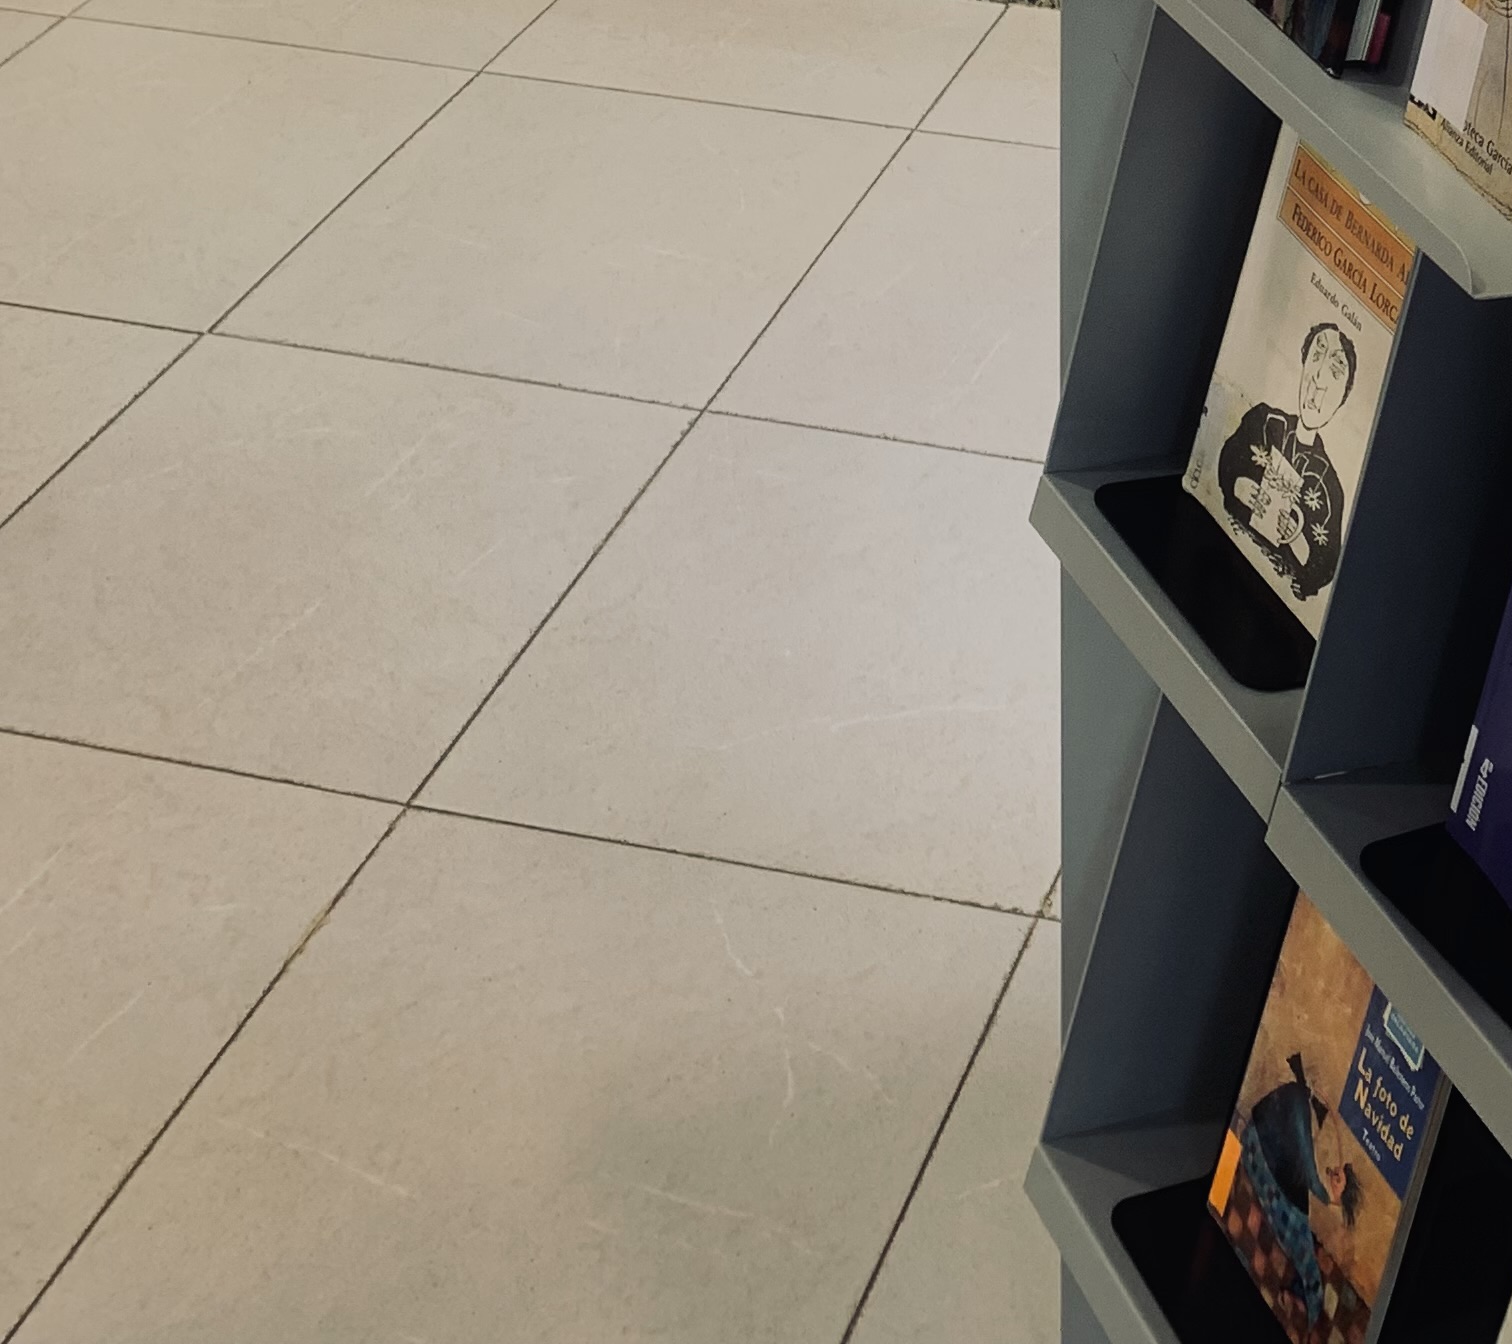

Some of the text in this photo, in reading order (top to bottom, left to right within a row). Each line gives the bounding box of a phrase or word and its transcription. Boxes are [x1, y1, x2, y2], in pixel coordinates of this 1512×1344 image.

[1330, 199, 1345, 222] DE
[1333, 247, 1368, 294] GARCÍA
[1354, 1077, 1405, 1162] Navidad
[1357, 1046, 1414, 1141] La foto de
